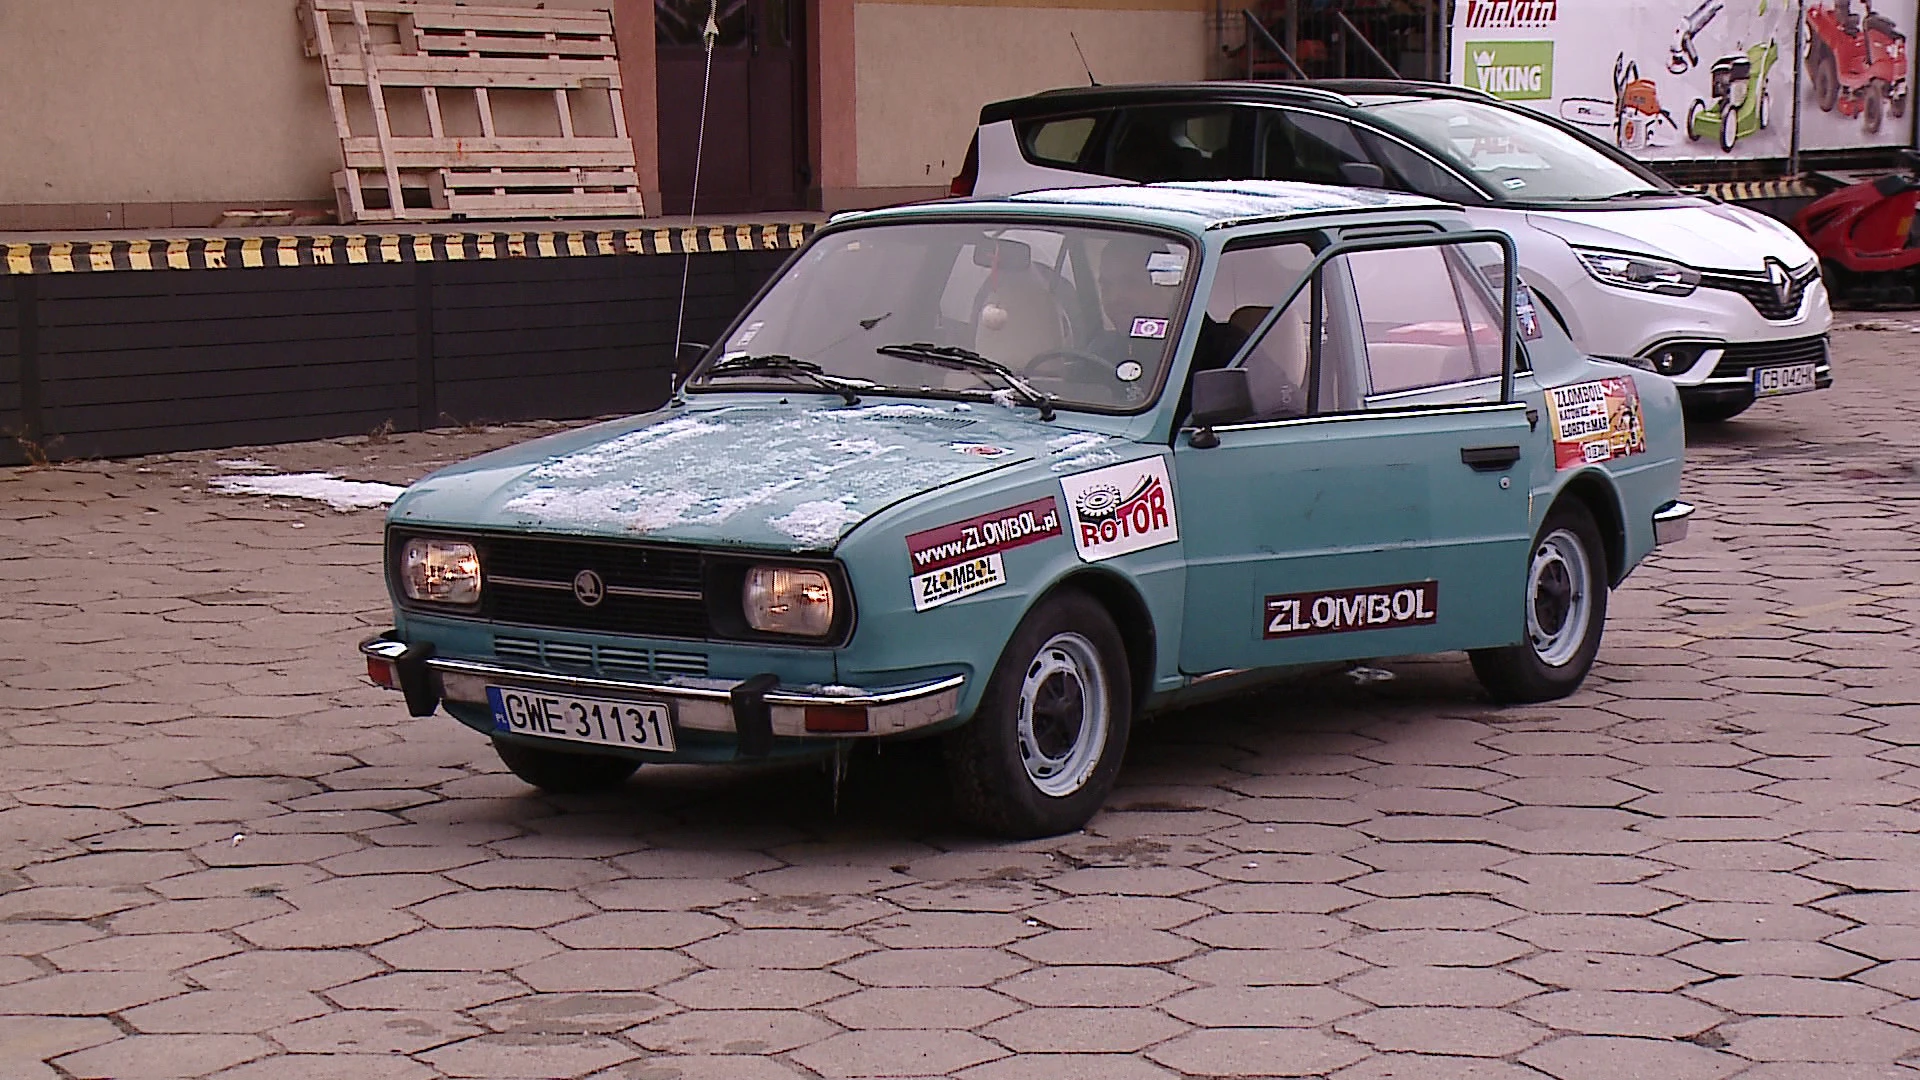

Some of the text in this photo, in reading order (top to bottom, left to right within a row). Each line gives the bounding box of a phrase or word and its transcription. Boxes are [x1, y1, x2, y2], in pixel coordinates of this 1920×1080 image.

[1477, 65, 1542, 92] VIKING
[1763, 370, 1778, 389] CB
[1081, 485, 1169, 548] ROTOR
[1268, 588, 1434, 633] ZLOMBOL
[506, 694, 664, 747] GWE 31131
